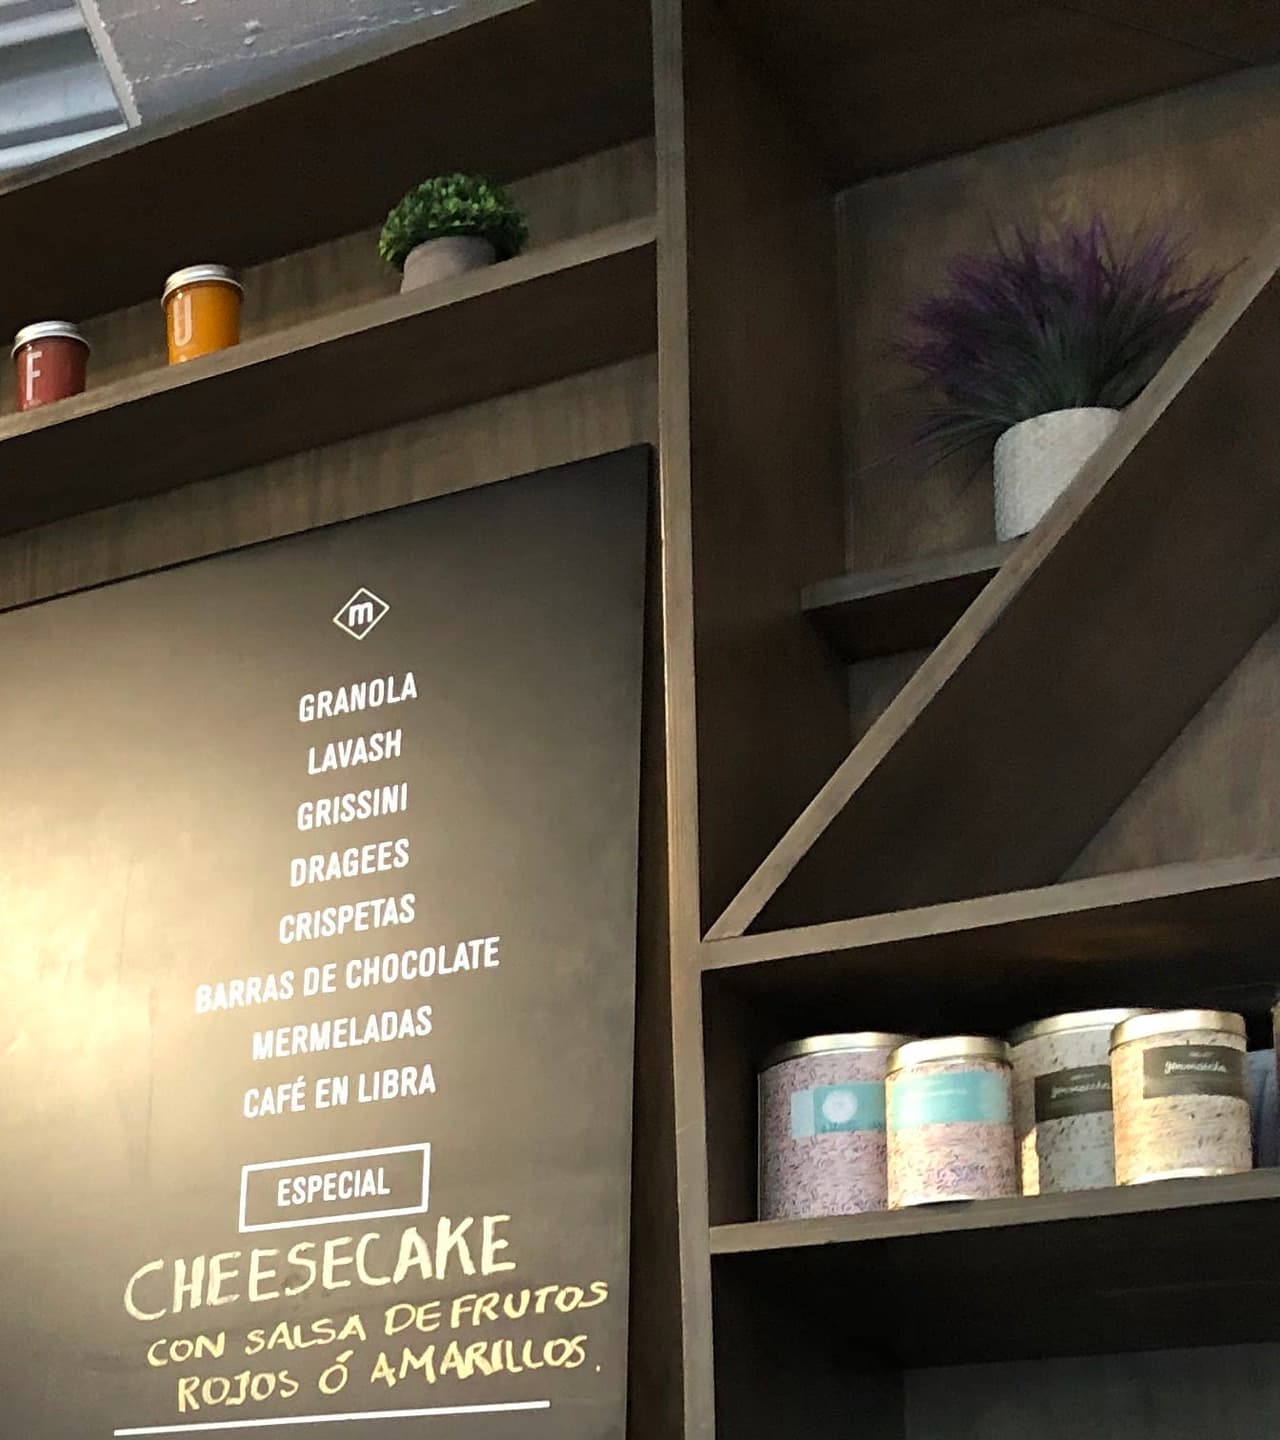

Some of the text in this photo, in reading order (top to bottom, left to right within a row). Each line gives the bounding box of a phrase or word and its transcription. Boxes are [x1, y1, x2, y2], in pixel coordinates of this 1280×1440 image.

[25, 350, 43, 401] F
[299, 672, 418, 722] GRANOLA
[308, 729, 403, 775] LAVASH
[297, 783, 408, 831] GRISSINI
[290, 839, 410, 887] DRAGEES
[279, 893, 416, 944] CRISPETAS
[196, 936, 500, 1013] BARRAS DE CHOCOLATE
[253, 1005, 432, 1060] MERMELADAS
[244, 1064, 436, 1118] CAFÉ EN LIBRA
[277, 1167, 390, 1206] ESPECIAL
[123, 1214, 517, 1321] CHEESECAKE
[147, 1281, 608, 1366] CON SALSA DE FRUTOS
[177, 1370, 299, 1413] ROJOS
[319, 1350, 355, 1394] Ó
